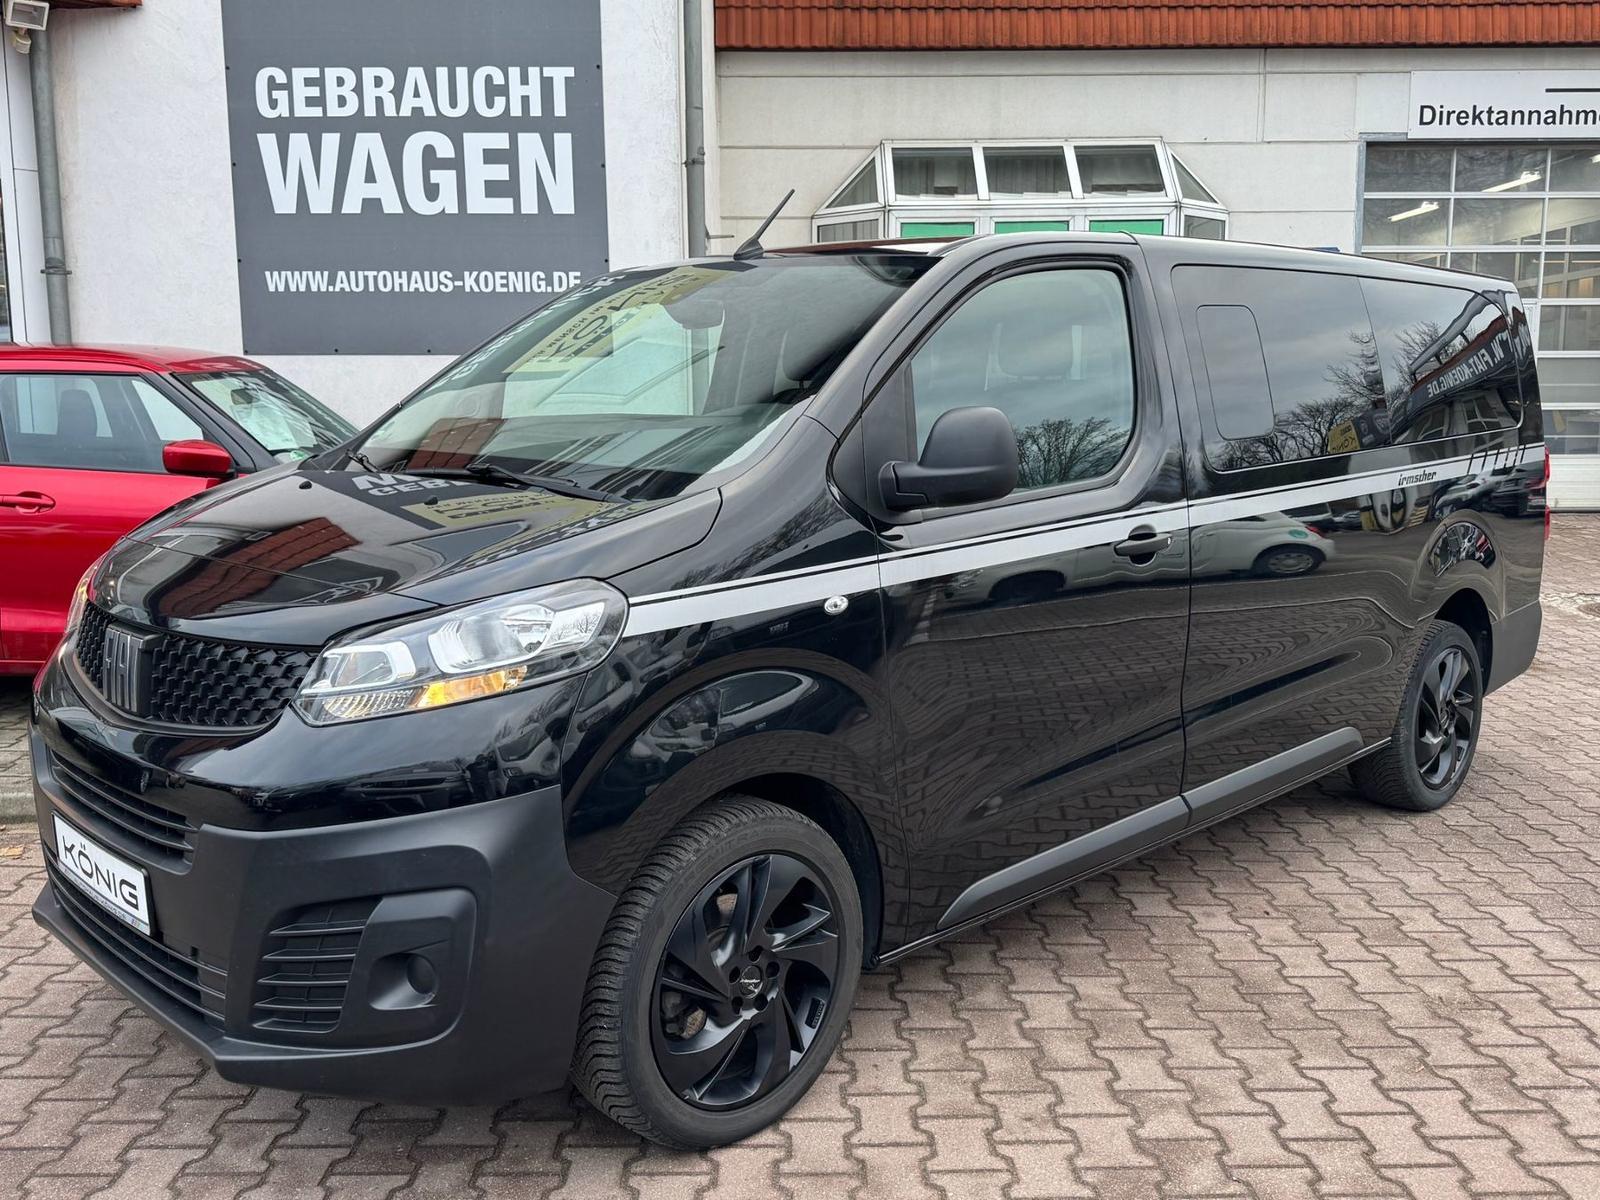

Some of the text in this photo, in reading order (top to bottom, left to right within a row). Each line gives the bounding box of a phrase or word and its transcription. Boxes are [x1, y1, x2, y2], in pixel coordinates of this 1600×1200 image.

[254, 66, 576, 119] GEBRAUCHT
[1418, 104, 1600, 127] Direktannahm
[256, 130, 576, 216] WAGEN
[264, 270, 582, 294] WWW.AUTOHAUS-KOENIG.DE
[1398, 469, 1437, 486] irmscher
[62, 835, 140, 912] KÖNIG
